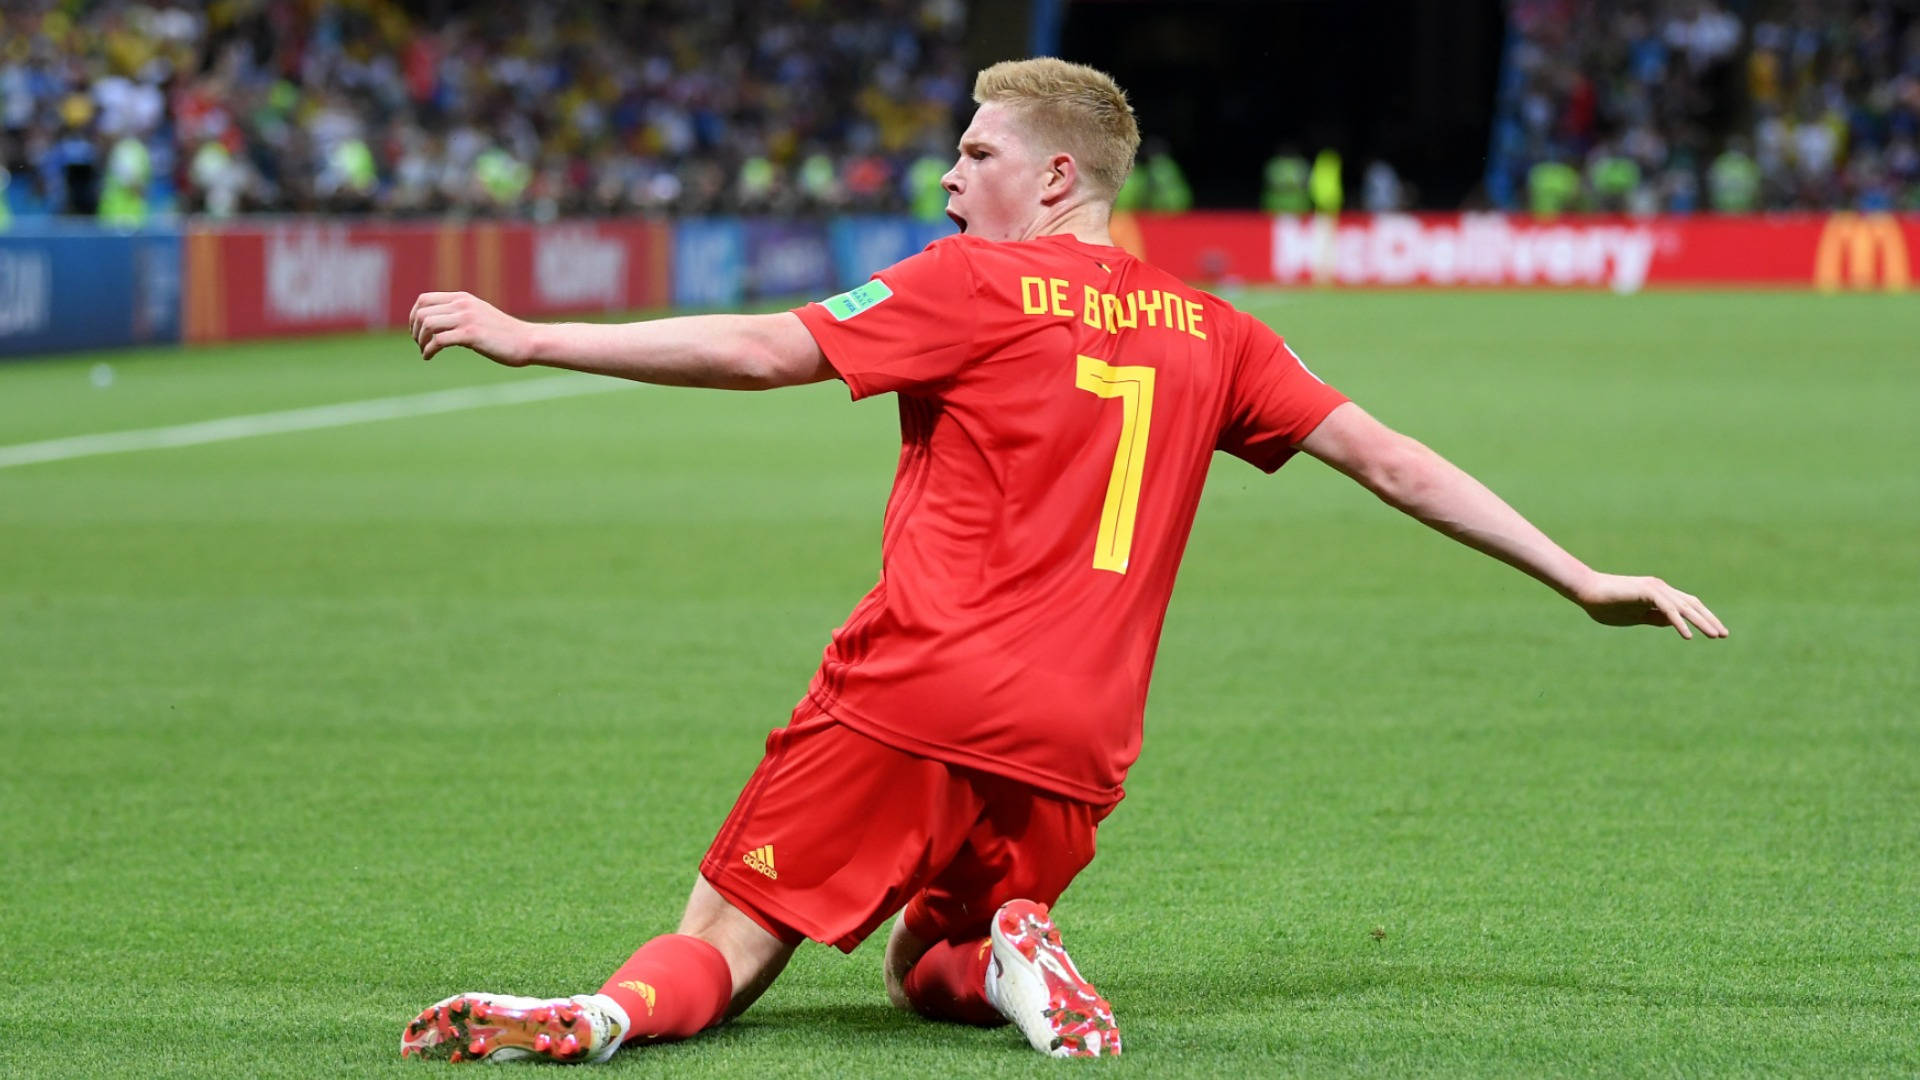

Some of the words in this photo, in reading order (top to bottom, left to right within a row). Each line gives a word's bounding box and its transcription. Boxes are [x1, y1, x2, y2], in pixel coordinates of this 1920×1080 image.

[1020, 276, 1075, 317] DE
[1083, 284, 1207, 340] BRUYNE
[1075, 354, 1156, 574] 7
[742, 854, 778, 880] adidas
